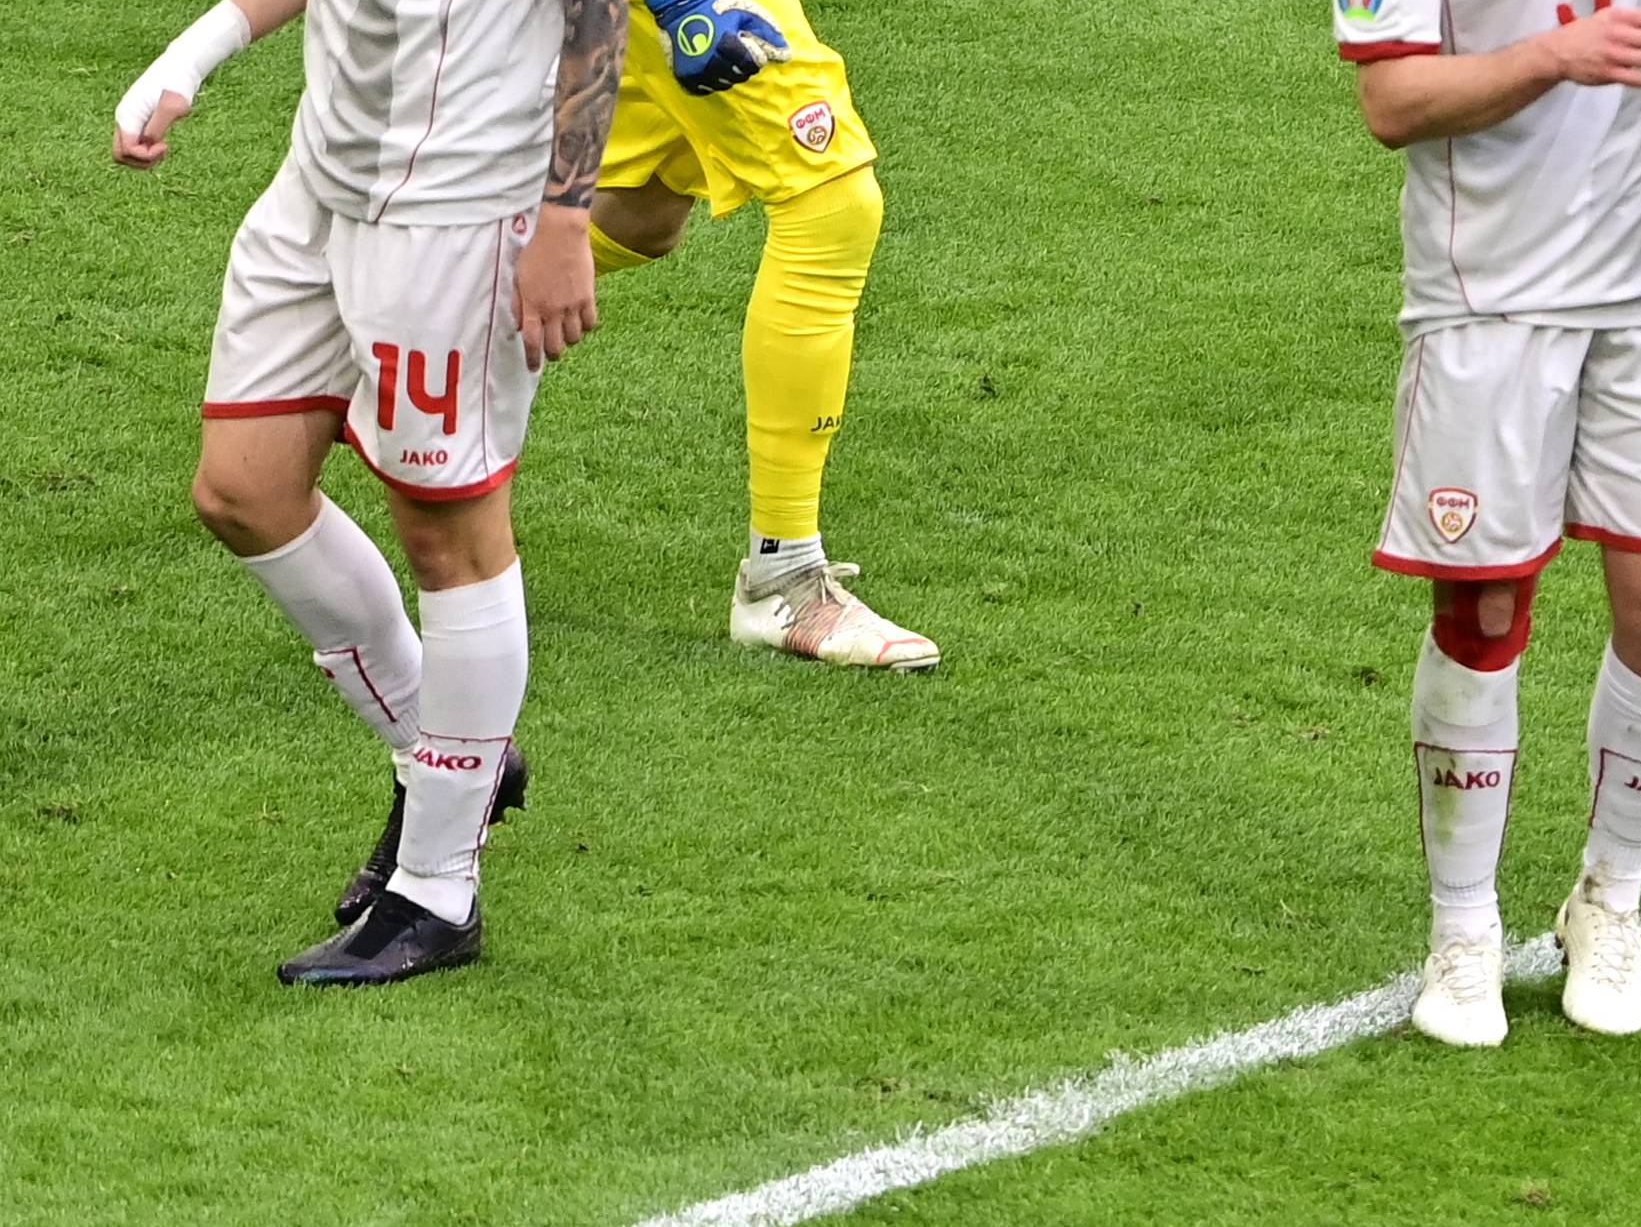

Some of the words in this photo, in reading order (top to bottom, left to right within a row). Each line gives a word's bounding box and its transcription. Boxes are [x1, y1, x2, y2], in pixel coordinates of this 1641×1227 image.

[372, 341, 461, 435] 14
[811, 416, 841, 432] JA
[400, 449, 448, 466] JAKO
[413, 747, 483, 771] JAKO
[1433, 766, 1501, 790] JAKO
